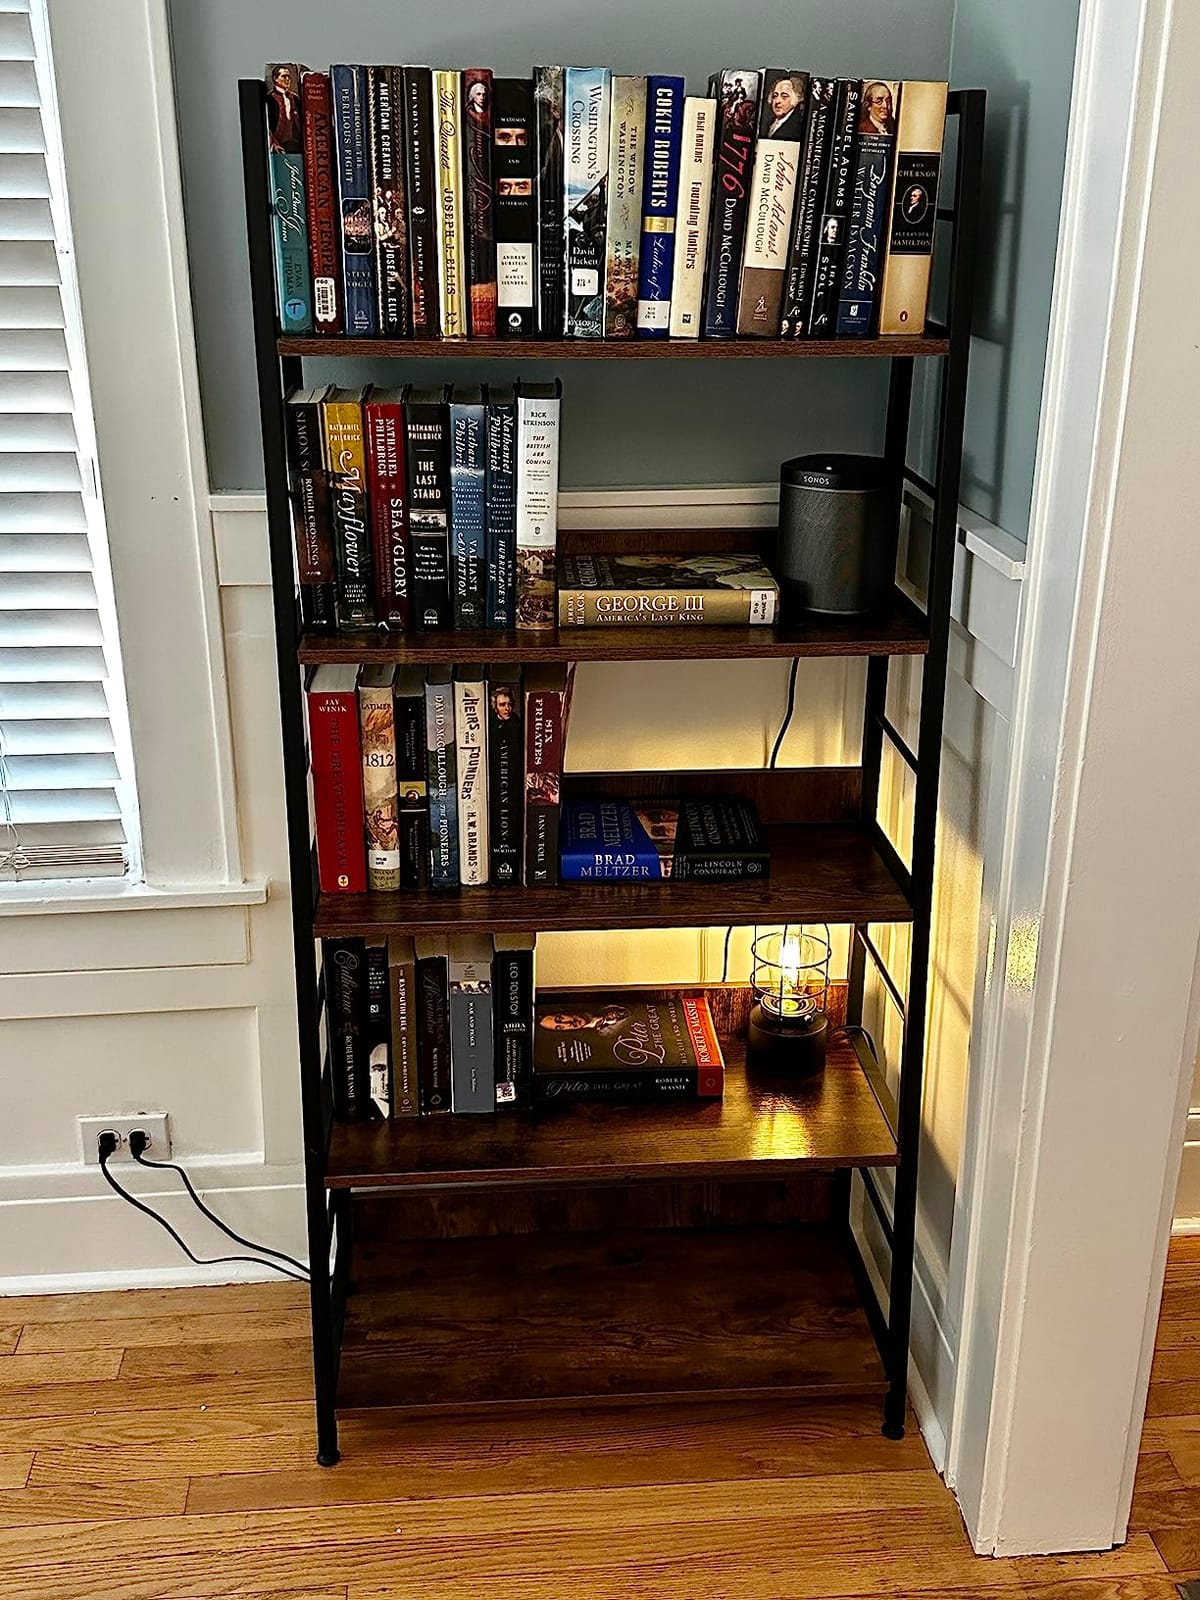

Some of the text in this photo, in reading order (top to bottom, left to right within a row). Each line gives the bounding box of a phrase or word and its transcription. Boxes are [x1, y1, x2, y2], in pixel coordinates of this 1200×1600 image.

[341, 88, 353, 184] PERILOUS FIGHT
[353, 102, 363, 169] THROUGH THE
[379, 82, 391, 179] AMERICAN CREATION
[411, 82, 421, 193] FOUNDING BROTHERS
[439, 88, 456, 170] The Quartet
[570, 100, 584, 164] CROSSING
[586, 86, 602, 180] WASHINGTON'S
[650, 87, 673, 208] COKIE ROBERTS
[694, 112, 705, 163] COKIE ROBERTS
[836, 91, 859, 207] SAMUEL ADAMS
[314, 111, 332, 209] AMERICAN
[616, 121, 627, 199] WASHINGTON
[627, 126, 638, 195] THE WIDOW
[719, 133, 751, 198] 1776
[775, 152, 795, 192] John
[801, 103, 828, 257] A MAGNIFICENT CATASTROPHE
[832, 146, 841, 169] LIFE
[685, 181, 702, 269] Founding Mothers
[754, 153, 773, 253] DAVID McCULLOUGH
[843, 166, 866, 290] WALTER ISAACSON
[857, 156, 887, 291] Benjamin Franklin
[416, 235, 424, 271] JOSEPH
[443, 187, 455, 295] JOSEPH J. ELLIS
[573, 246, 595, 255] David
[716, 198, 737, 307] DAVID McCULLOUGH
[285, 255, 294, 296] THOMAS
[294, 262, 303, 288] EVAN
[386, 249, 397, 322] JOSEPH J. ELLIS
[817, 256, 829, 298] STOLL
[827, 264, 837, 287] IRA
[295, 411, 310, 455] SIMON
[330, 433, 360, 441] PHILBRICK
[375, 418, 386, 477] PHILBRICK
[387, 418, 397, 477] NATHANIEL
[454, 420, 467, 476] Philbrick
[466, 418, 479, 478] Nathaniel
[489, 415, 501, 471] Philbrick
[502, 414, 513, 474] Nathaniel
[413, 489, 441, 499] STAND
[416, 475, 437, 486] LAST
[418, 461, 435, 471] THE
[803, 476, 830, 485] SONOS
[305, 478, 315, 513] ROUGH
[336, 450, 364, 577] Mayflower
[307, 515, 320, 566] CROSSINGS
[390, 498, 406, 598] SEA of GLORY
[457, 531, 467, 596] AMBITION
[468, 540, 477, 592] VALIANT
[507, 560, 512, 569] IN
[498, 539, 506, 604] HURRICANE'S
[576, 593, 584, 624] BLACK
[595, 595, 704, 612] GEORGE III
[595, 613, 704, 623] AMERICA'S LAST KING
[361, 703, 392, 711] LATIMER
[461, 697, 480, 730] HEIRS
[534, 698, 543, 765] FRIGATES
[544, 719, 553, 743] SIX
[364, 754, 394, 767] 1812
[435, 695, 446, 796] DAVID McCULLOUGH
[471, 733, 475, 742] OF
[329, 718, 346, 869] THE GREAT UPHEAVAL
[459, 746, 481, 800] FOUNDERS
[500, 743, 508, 836] AMERICAN LION
[439, 819, 449, 867] PIONEERS
[468, 832, 476, 867] BRANDS
[594, 854, 636, 866] BRAD
[580, 866, 650, 877] MELTZER
[333, 949, 359, 1014] Catherine
[509, 962, 518, 1016] LEO TOLSTOY
[646, 1004, 663, 1047] THE GREAT
[668, 1001, 677, 1023] WORLD
[686, 1001, 711, 1062] ROBERT MASSIE
[345, 1035, 355, 1099] ROBERT MASSIE
[612, 1022, 666, 1065] Peter
[546, 1080, 590, 1097] Peter
[613, 1081, 643, 1089] GREAT
